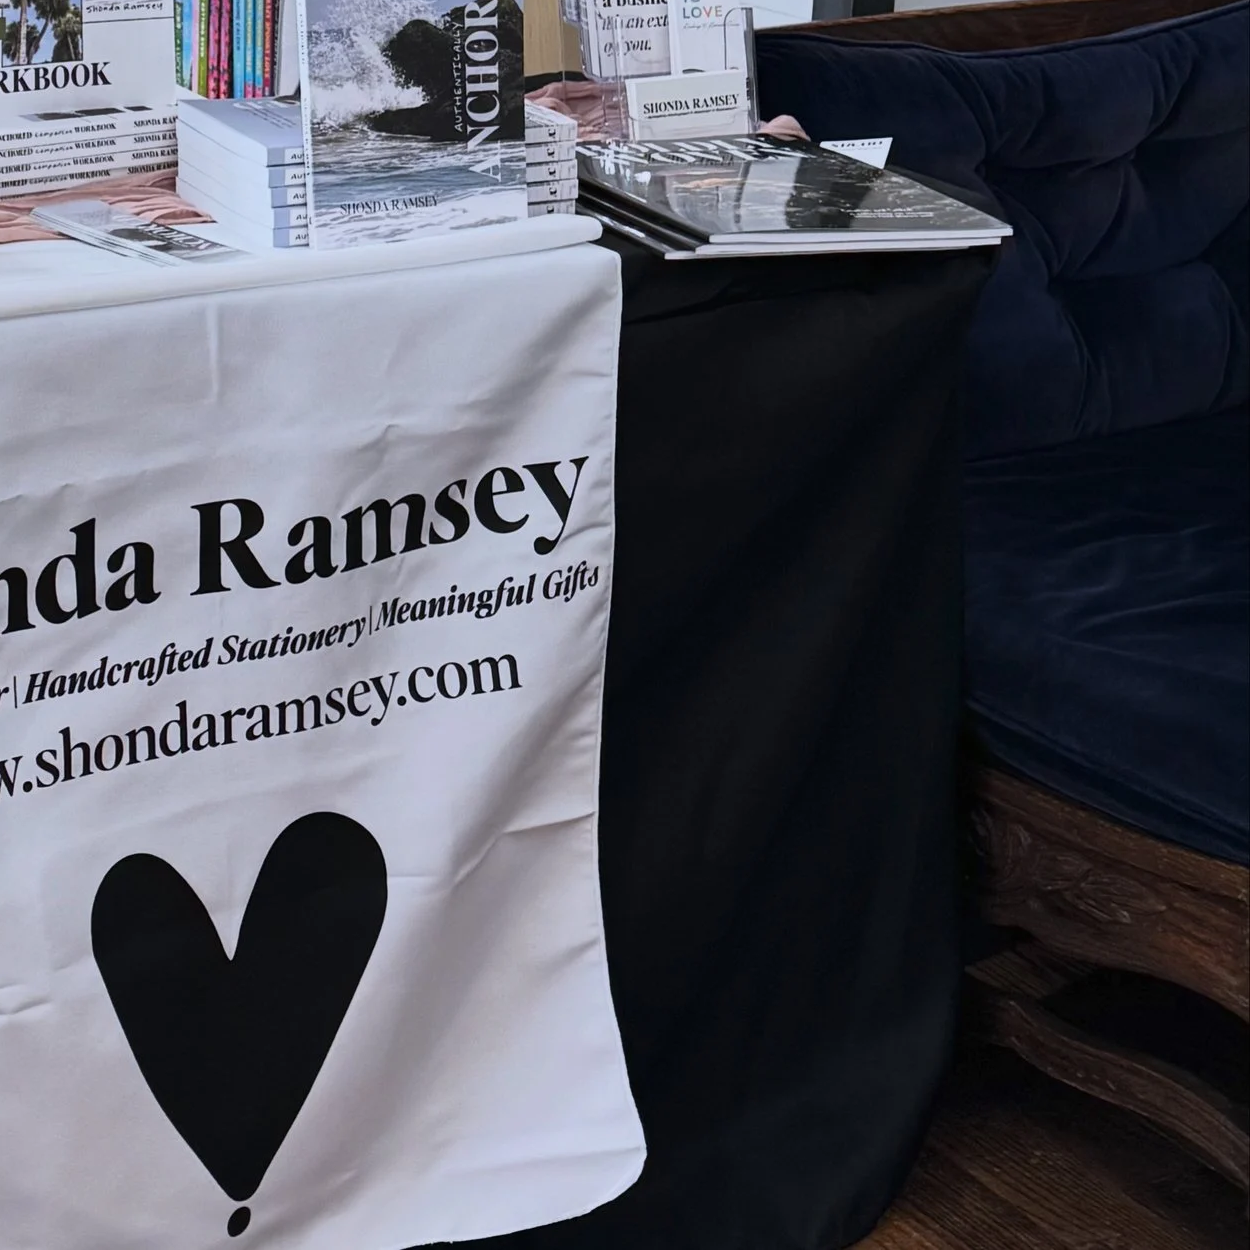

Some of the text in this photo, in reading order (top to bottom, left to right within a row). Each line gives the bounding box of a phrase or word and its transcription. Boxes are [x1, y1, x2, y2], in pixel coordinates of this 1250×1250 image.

[85, 1, 164, 14] Shonda Ramsey
[682, 6, 723, 20] LOVE
[453, 20, 463, 133] AUTHENTICALLY
[643, 93, 740, 115] SHONDA RAMSEY
[73, 122, 117, 134] WORKBOOK
[74, 138, 117, 150] WORKBOOK
[340, 194, 440, 216] SHONDA RAMSEY
[189, 455, 590, 596] Ramsey
[541, 560, 600, 603] Gifts
